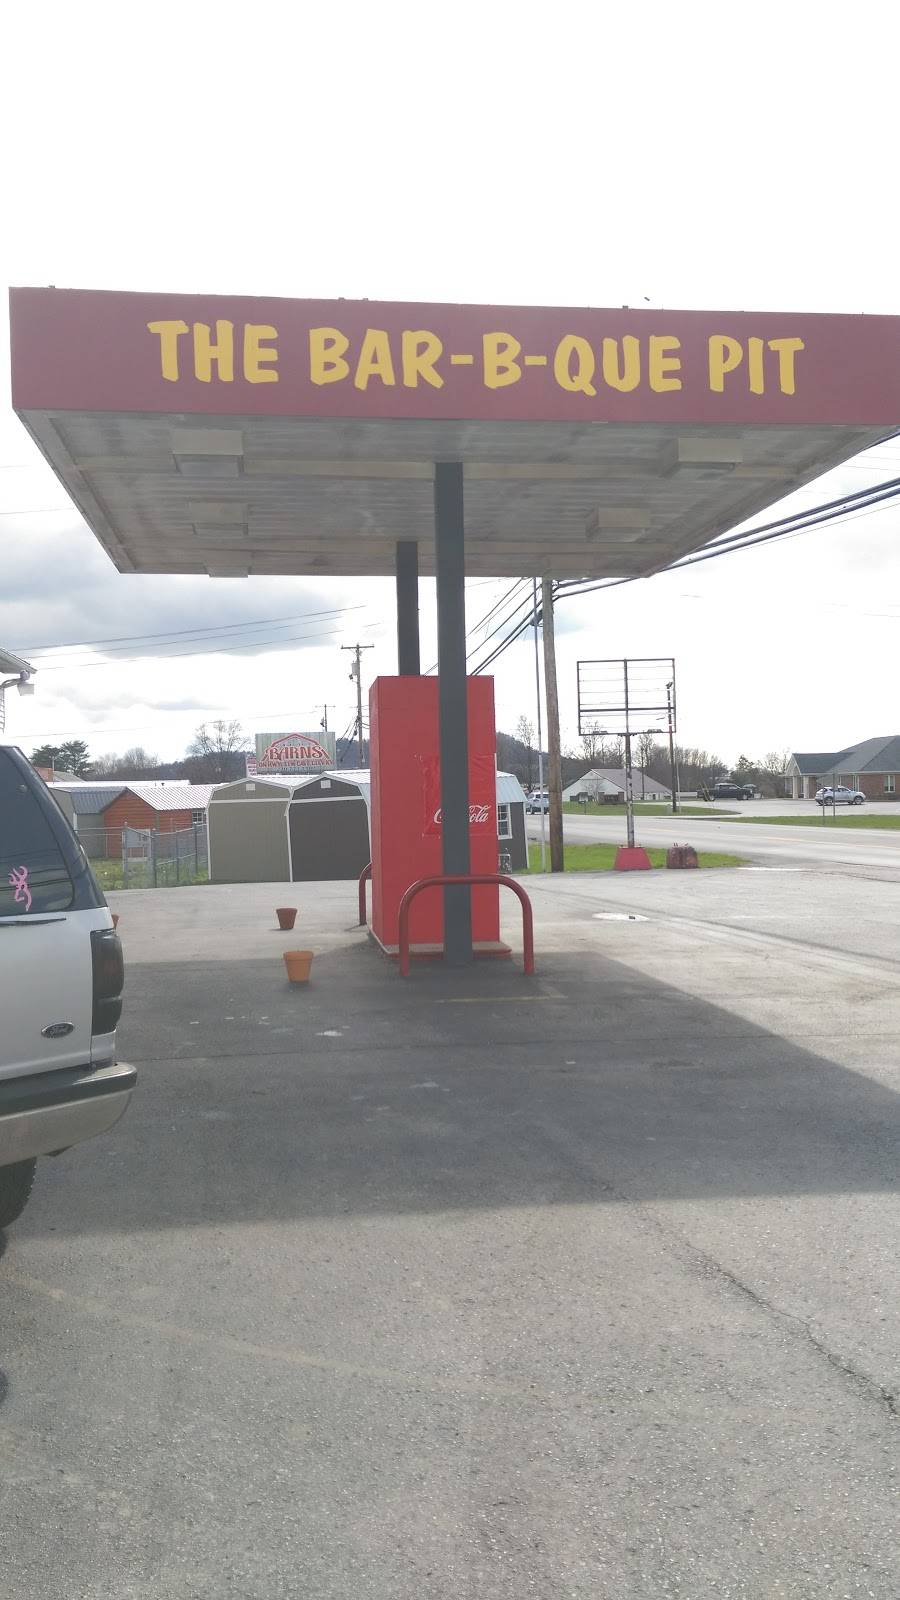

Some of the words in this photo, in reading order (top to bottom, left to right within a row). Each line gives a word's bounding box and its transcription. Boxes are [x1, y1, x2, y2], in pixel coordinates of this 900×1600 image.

[147, 318, 278, 384] THE
[308, 328, 682, 397] BAR-B-QUE
[708, 335, 805, 395] PIT
[269, 745, 323, 760] BARNS
